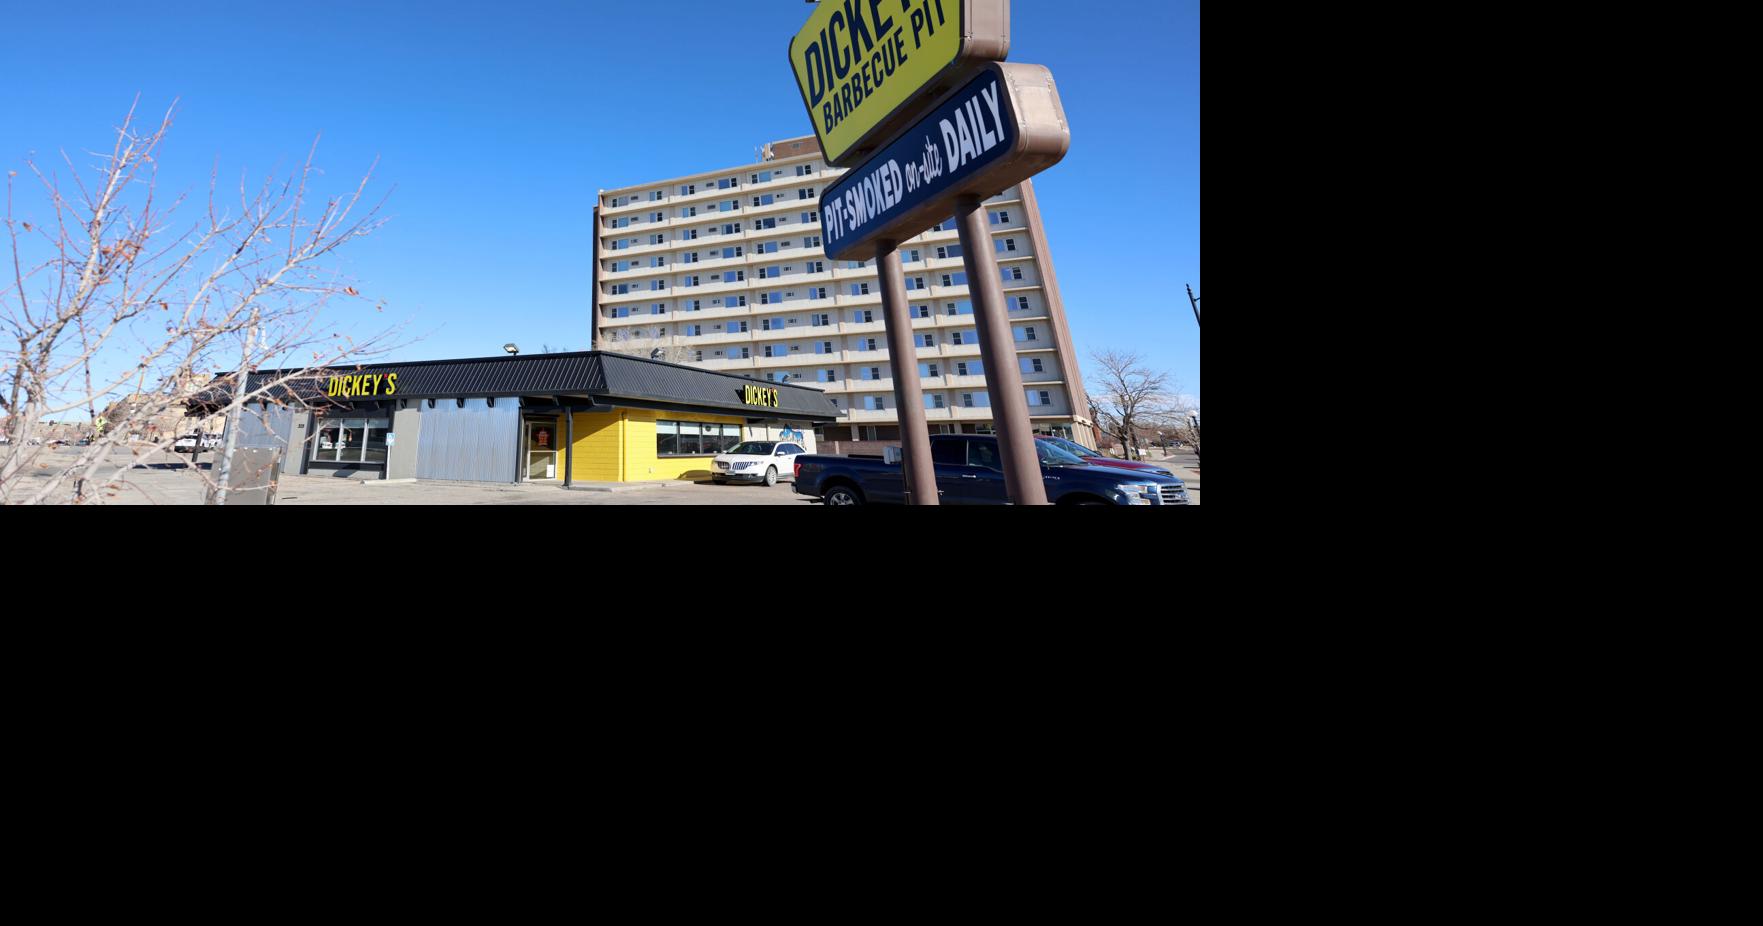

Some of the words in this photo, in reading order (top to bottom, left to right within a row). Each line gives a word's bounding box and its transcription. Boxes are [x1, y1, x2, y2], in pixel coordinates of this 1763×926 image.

[805, 0, 911, 109] DICKE
[823, 26, 908, 135] BARBECUE
[824, 159, 903, 244] PIT-SMOKED
[905, 136, 942, 192] on-site
[939, 81, 1005, 173] DAILY
[328, 373, 398, 397] DICKEY'S
[744, 384, 779, 408] DICKEY'S
